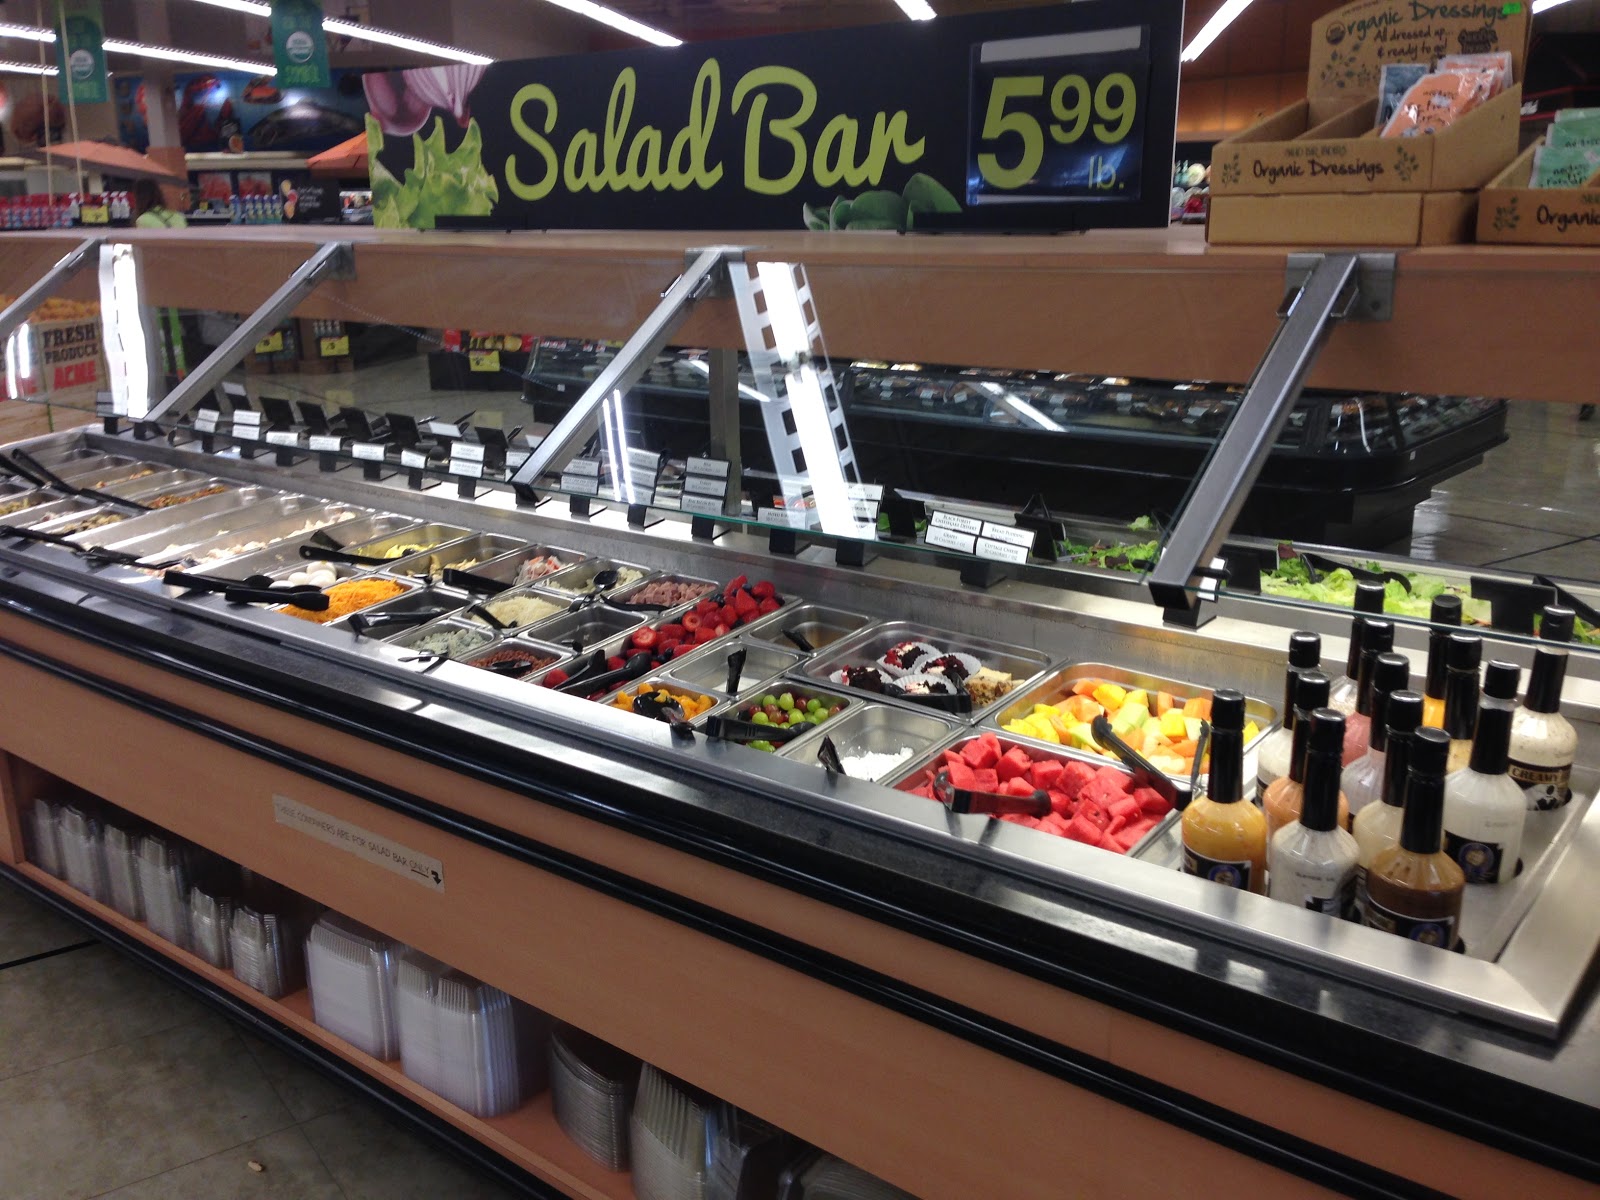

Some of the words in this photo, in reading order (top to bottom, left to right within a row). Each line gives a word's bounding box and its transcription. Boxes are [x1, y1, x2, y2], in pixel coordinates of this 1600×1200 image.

[1408, 0, 1509, 27] Dressings
[1374, 28, 1387, 42] All
[1390, 25, 1431, 40] dressed
[1387, 44, 1419, 61] ready
[1421, 44, 1432, 53] to
[505, 57, 723, 201] Salad
[731, 65, 925, 195] Bar
[1088, 156, 1124, 190] lb.
[1253, 160, 1304, 184] Organic
[1308, 158, 1384, 182] Dressings
[43, 323, 96, 349] FRESH
[45, 343, 98, 364] PRODUCE
[54, 361, 97, 391] ACME
[368, 841, 391, 857] SALAD
[392, 852, 408, 866] BAR
[409, 860, 430, 875] ONLY
